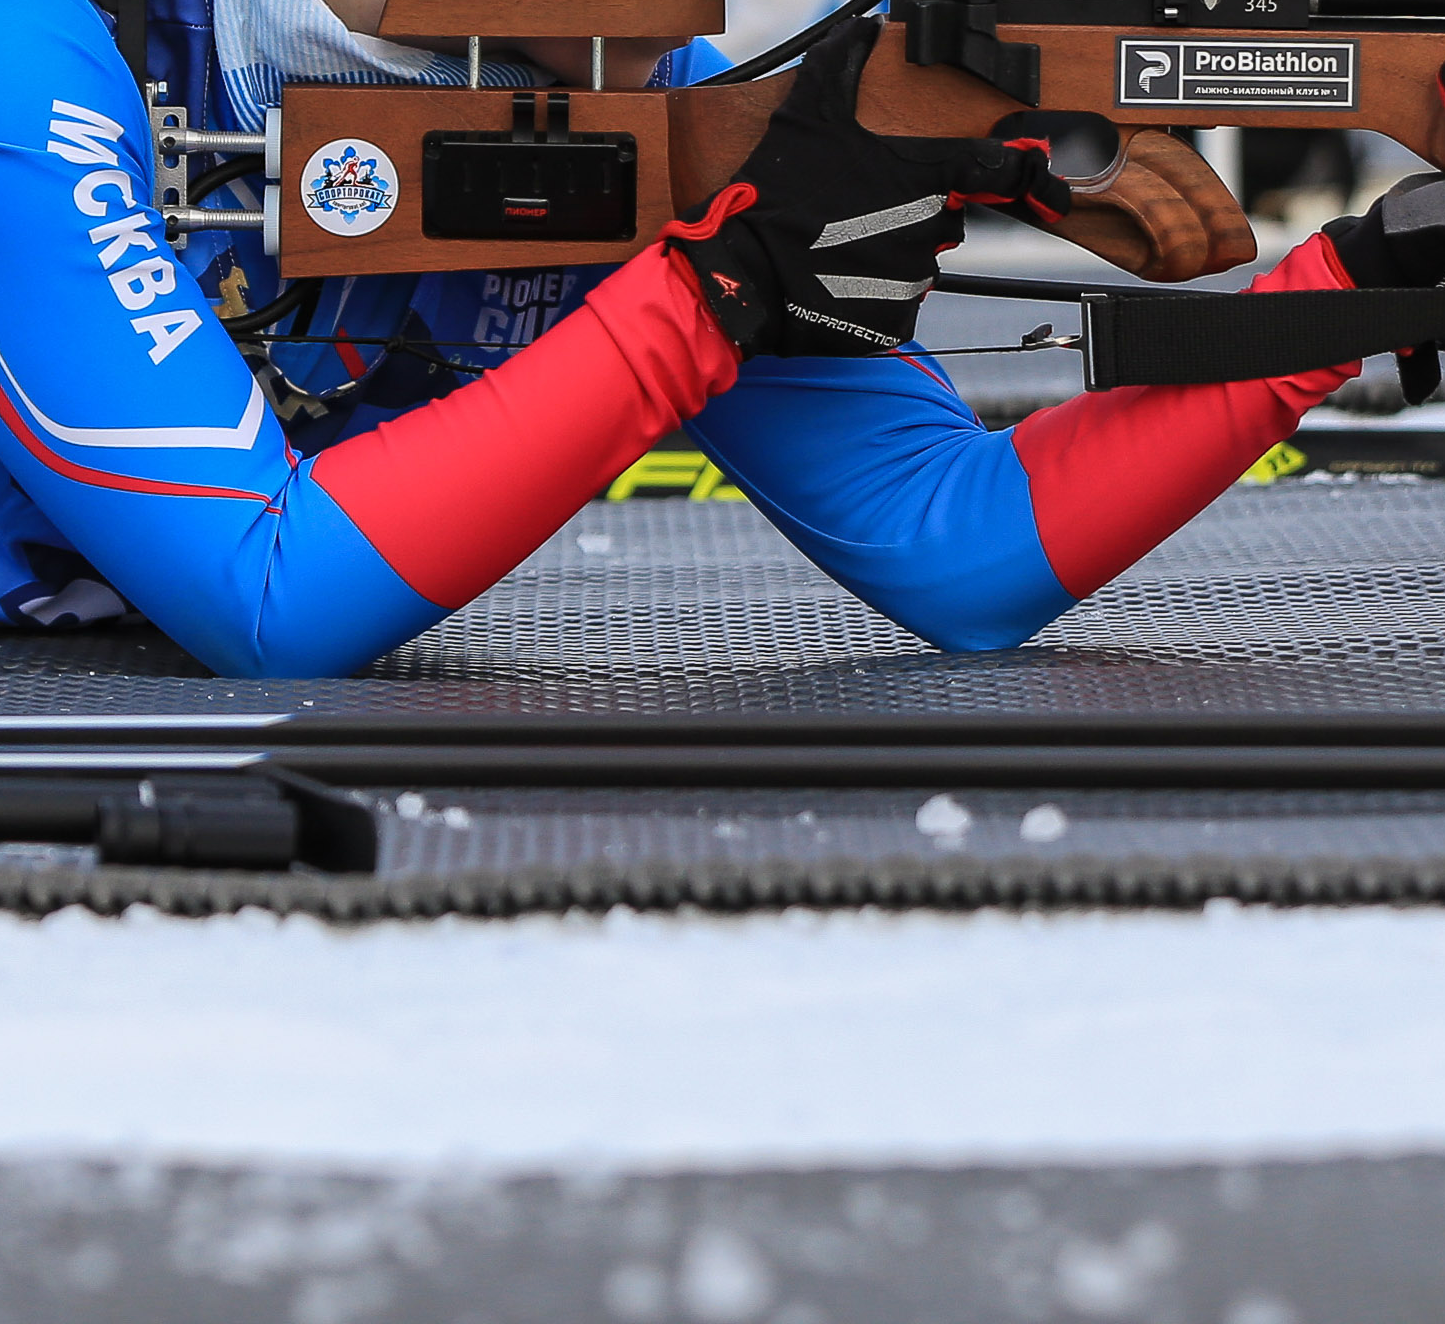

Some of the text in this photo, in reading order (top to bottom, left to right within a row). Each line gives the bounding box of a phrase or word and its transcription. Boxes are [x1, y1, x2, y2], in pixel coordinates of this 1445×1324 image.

[1195, 50, 1338, 73] ProBiathlon
[1194, 86, 1294, 96] ЛЫЖНО-БИАТЛОННЫЙ
[1295, 88, 1319, 96] КЛУБ
[318, 187, 382, 201] СПОРТПРОКАТ
[505, 207, 548, 217] ПИОНЕР
[46, 99, 204, 366] МСКВА
